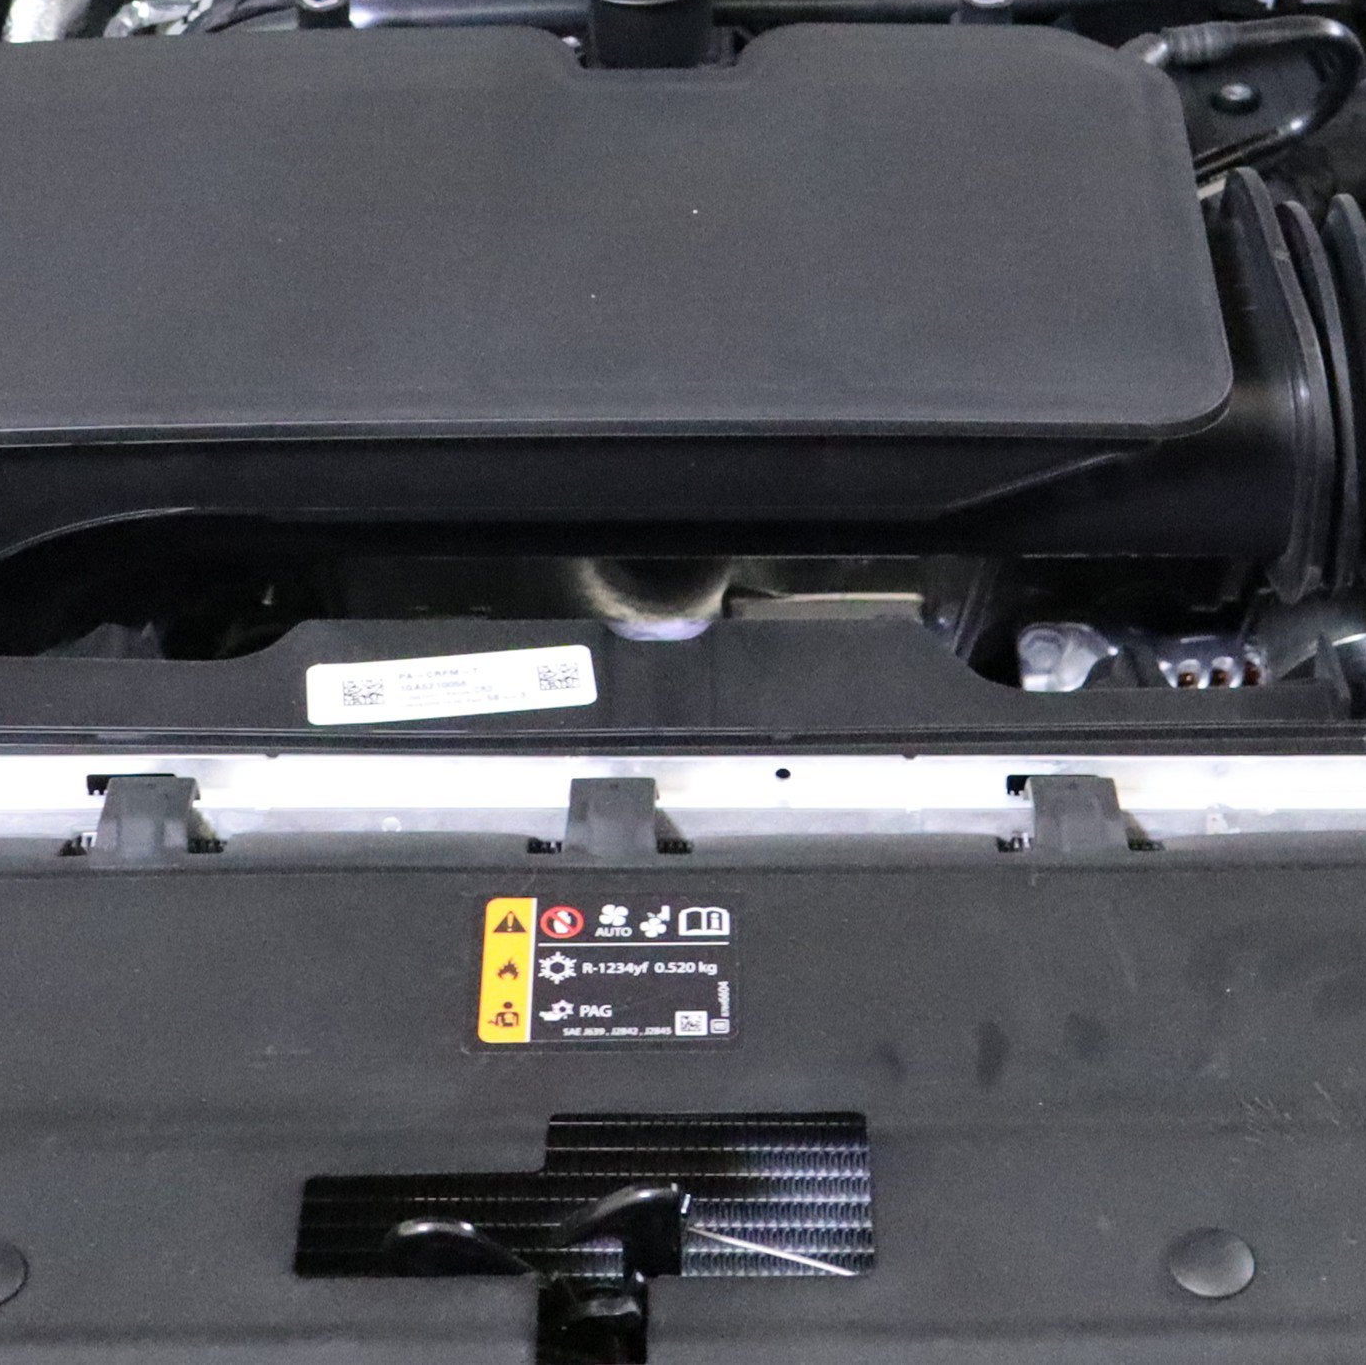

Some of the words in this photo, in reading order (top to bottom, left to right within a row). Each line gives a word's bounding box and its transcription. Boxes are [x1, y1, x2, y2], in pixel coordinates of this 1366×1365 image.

[594, 927, 633, 937] AUTO
[581, 961, 649, 976] R-1234yf
[654, 961, 696, 974] 0.520
[698, 961, 718, 976] kg
[579, 1004, 613, 1018] PAG
